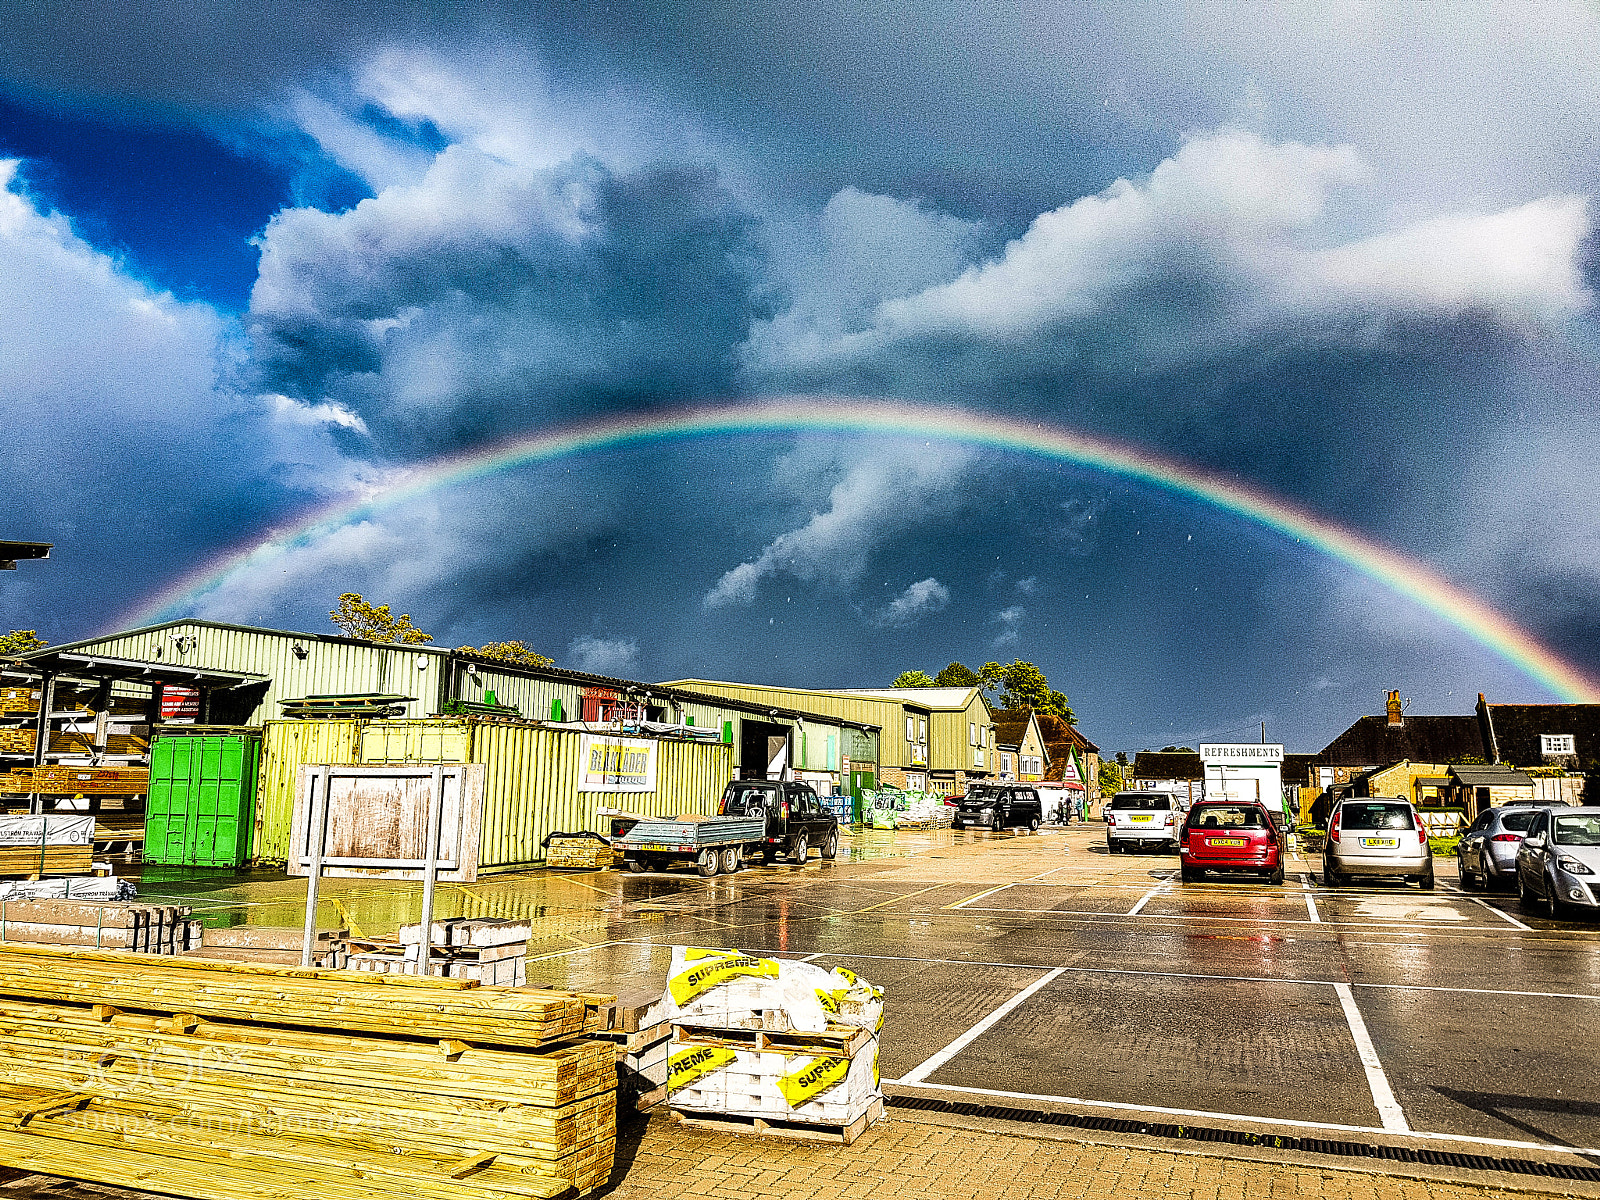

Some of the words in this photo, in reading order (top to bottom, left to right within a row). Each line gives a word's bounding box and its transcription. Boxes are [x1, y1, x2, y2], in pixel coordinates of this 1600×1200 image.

[590, 745, 647, 773] BLÅKLÄDER
[1204, 747, 1280, 757] REFRESHMENTS
[687, 957, 761, 987] SUPREME
